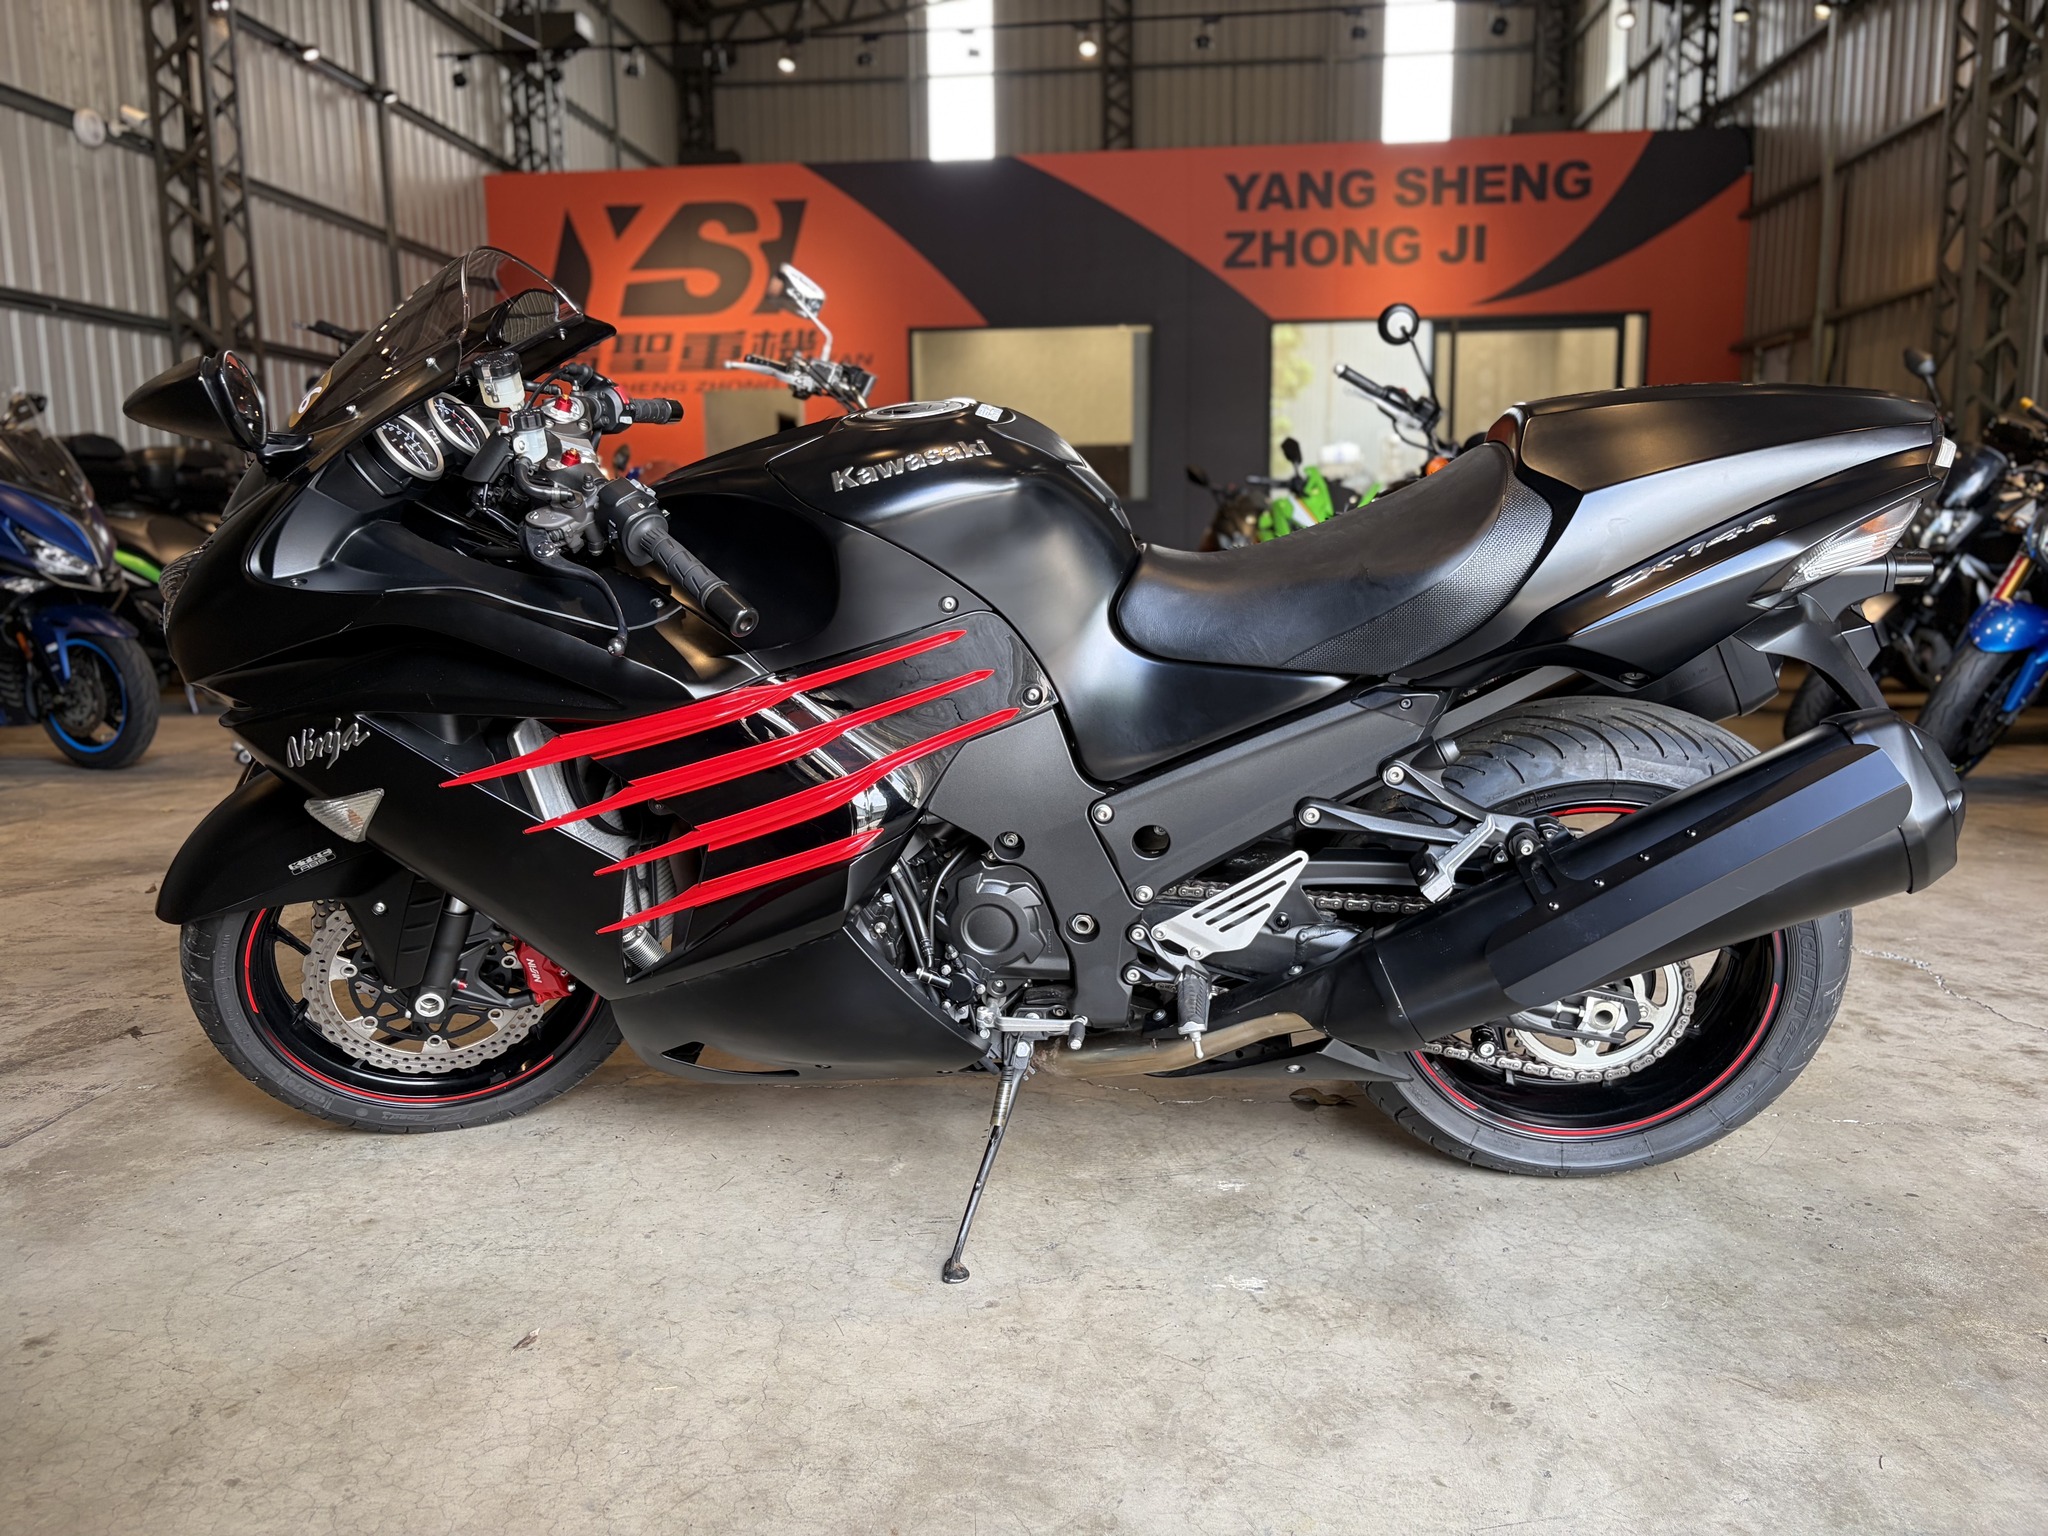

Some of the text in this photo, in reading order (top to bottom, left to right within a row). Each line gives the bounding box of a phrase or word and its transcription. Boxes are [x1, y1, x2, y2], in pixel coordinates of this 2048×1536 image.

[1225, 160, 1593, 210] YANG SHENG
[1224, 225, 1487, 269] ZHONG JI
[831, 438, 993, 493] Kawasaki
[1605, 514, 1777, 598] ZX-14R
[286, 717, 371, 770] Ninja
